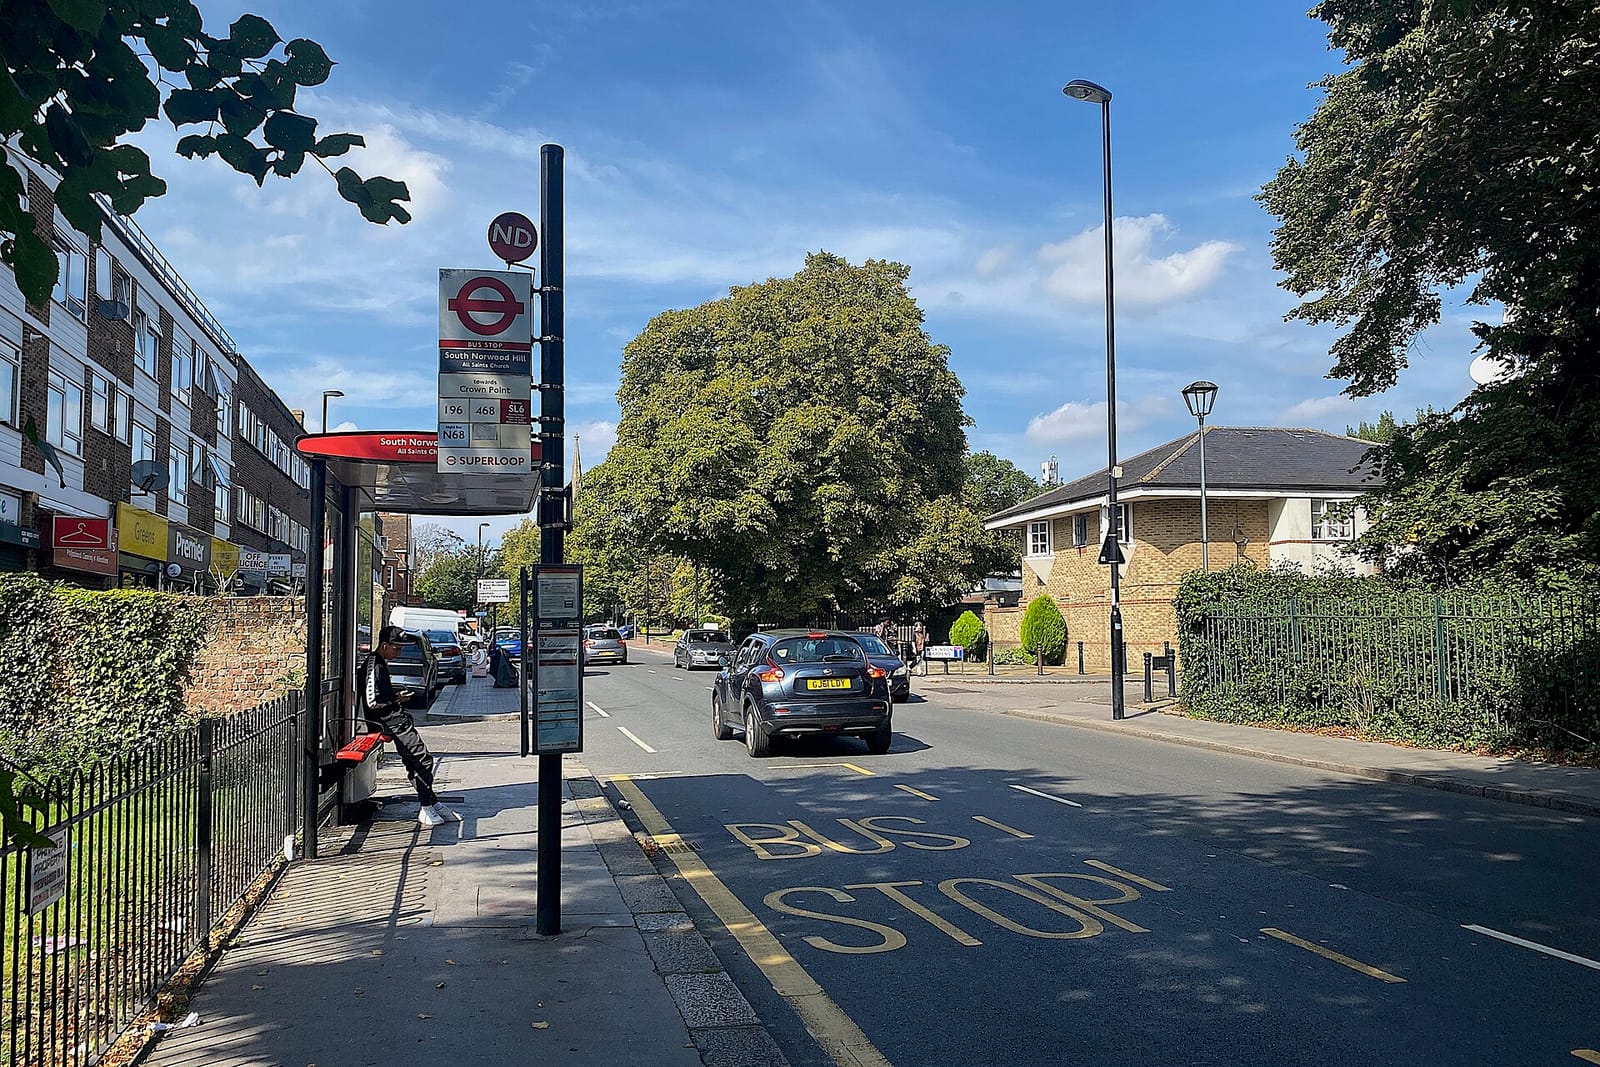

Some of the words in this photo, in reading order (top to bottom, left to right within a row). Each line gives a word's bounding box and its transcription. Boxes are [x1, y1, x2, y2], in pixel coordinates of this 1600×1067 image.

[492, 222, 533, 248] ND
[444, 351, 469, 360] South
[471, 352, 510, 361] Norwood
[512, 354, 527, 362] Hill
[459, 385, 487, 393] Crown
[488, 386, 511, 394] Point
[444, 405, 463, 415] 196
[475, 406, 495, 415] 468
[508, 404, 525, 414] SL6
[442, 430, 465, 440] N68
[380, 437, 407, 446] South
[397, 447, 407, 455] All
[460, 456, 525, 466] SUPERLOOP
[134, 521, 155, 545] Greens
[175, 530, 205, 562] Premier
[245, 552, 262, 561] OFF
[240, 559, 267, 569] LICENCE
[724, 816, 971, 860] BUS
[763, 872, 1152, 955] STOP
